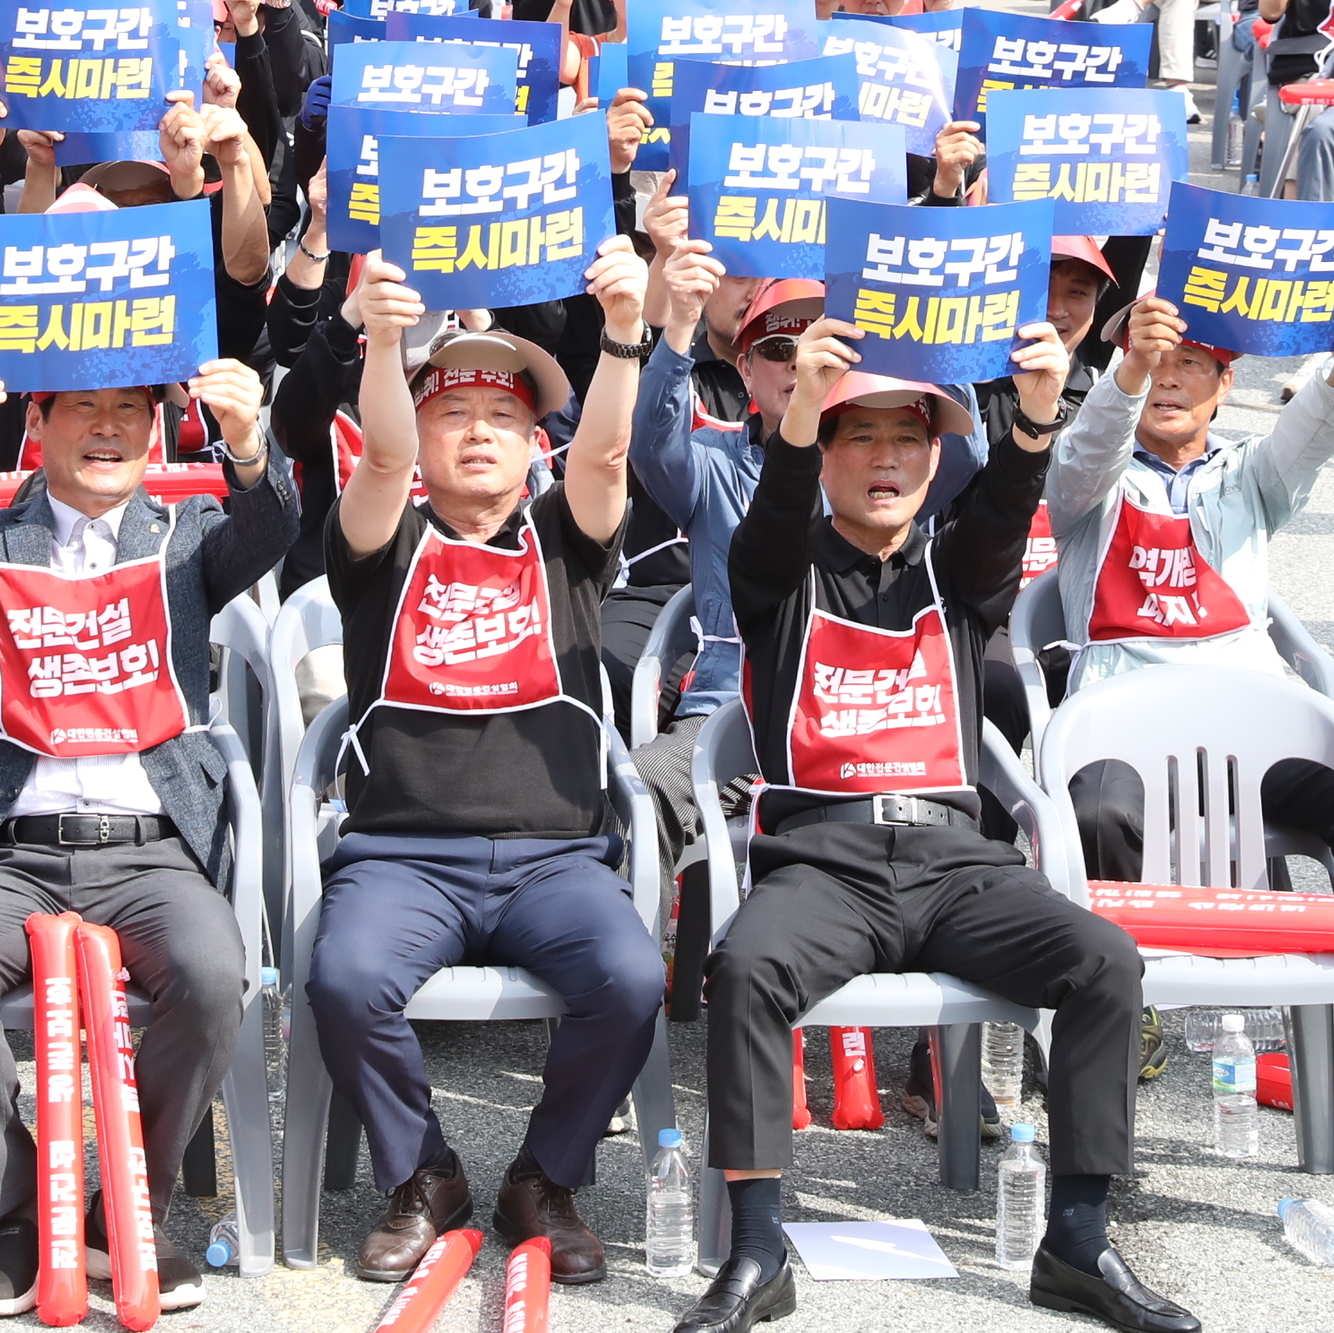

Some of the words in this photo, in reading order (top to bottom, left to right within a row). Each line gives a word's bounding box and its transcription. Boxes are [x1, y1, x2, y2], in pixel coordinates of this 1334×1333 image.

[13, 7, 154, 50] 보호구간
[6, 57, 146, 98] 즉시마련
[1021, 114, 1161, 154] 보호구간
[420, 150, 582, 221] 보호구간
[1012, 162, 1161, 204] 즉시마련
[1, 237, 174, 295] 보호구간
[413, 215, 579, 272] 즉시마련
[864, 233, 1023, 286] 보호구간
[850, 290, 1017, 343] 즉시마련
[444, 368, 476, 387] 전문
[7, 597, 132, 650] 전문건설
[418, 574, 520, 622] 전문건설
[413, 596, 541, 667] 생존보호!
[27, 639, 160, 698] 생존보호!
[445, 681, 518, 693] 대한전문건설협회
[67, 729, 138, 741] 대한전문건설협회
[820, 684, 946, 738] 생존보호!
[857, 761, 926, 773] 대한전문건설협회
[45, 977, 72, 1103] 생존보호
[49, 1140, 78, 1269] 전문건설
